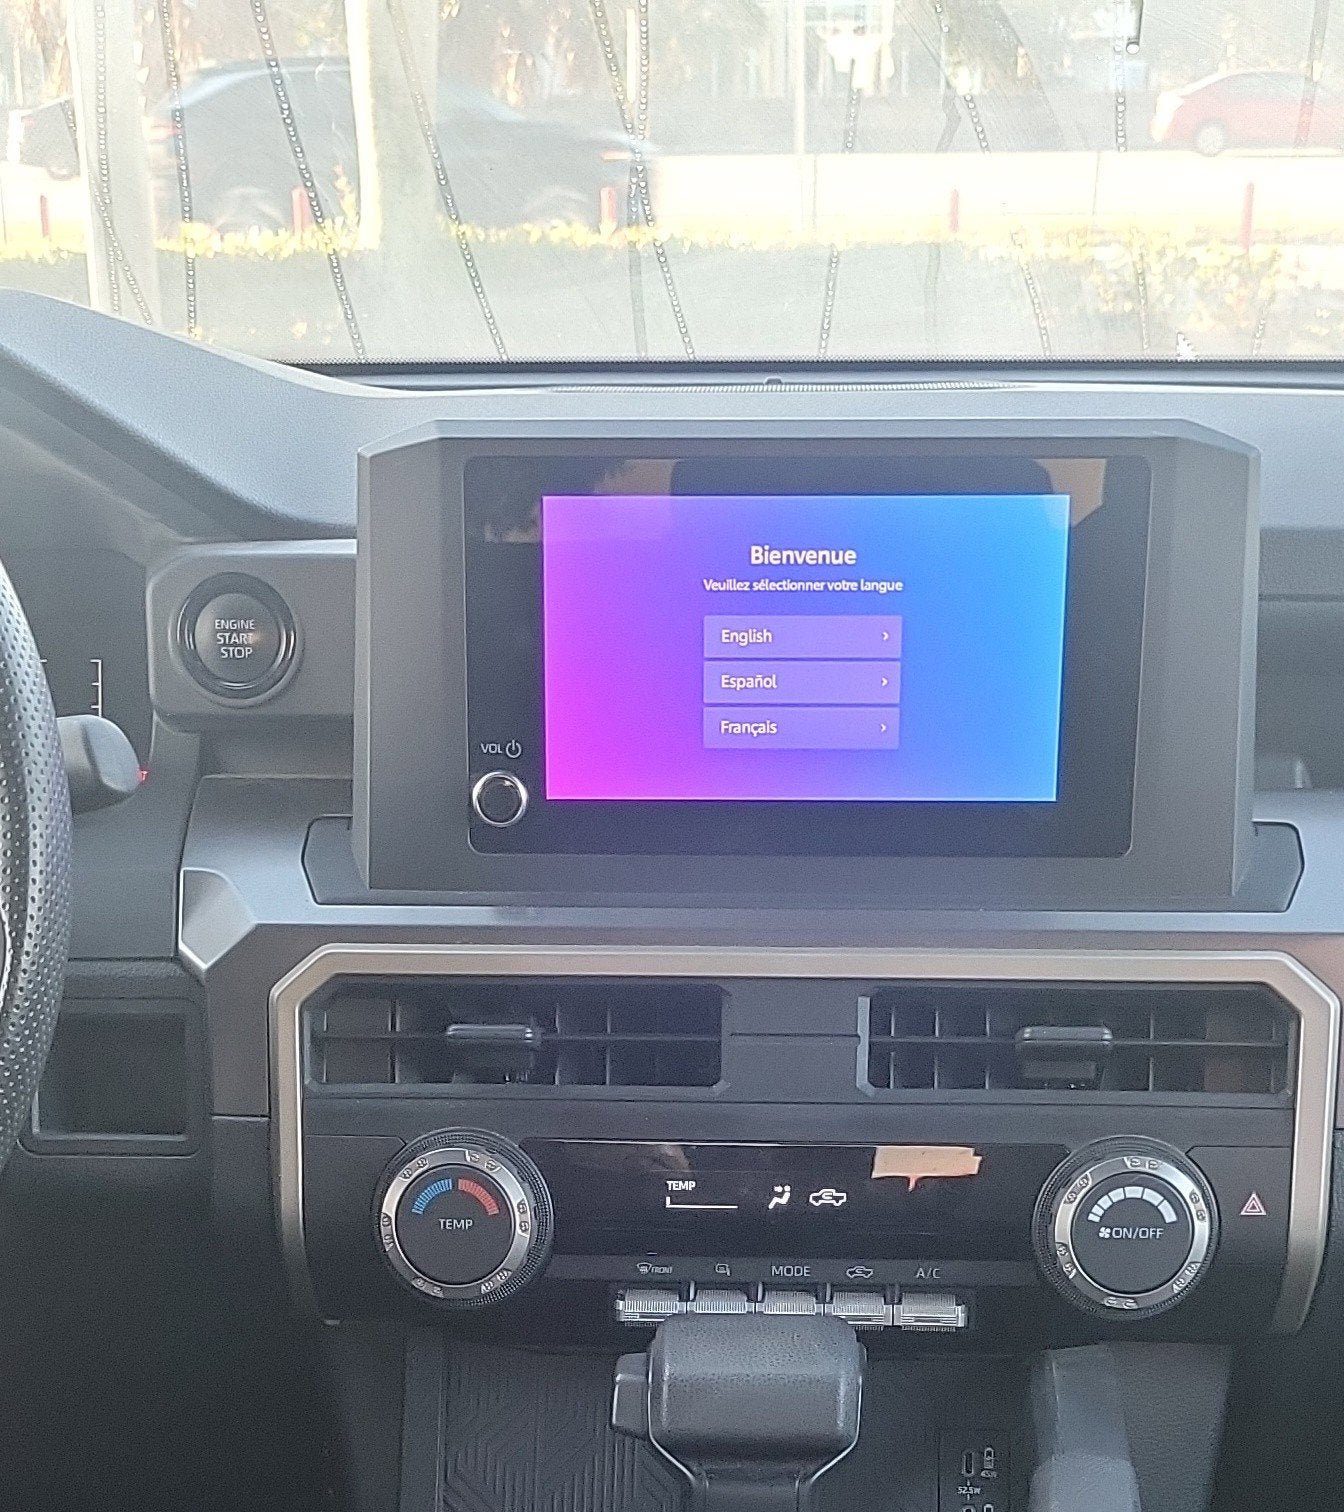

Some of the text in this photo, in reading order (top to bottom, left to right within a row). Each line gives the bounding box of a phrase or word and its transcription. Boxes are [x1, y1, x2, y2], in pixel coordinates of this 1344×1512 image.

[750, 545, 857, 565] Bienvenue
[703, 578, 904, 594] Veuillez sélectionner votre langue
[214, 619, 256, 630] ENGINE
[216, 632, 254, 645] START
[721, 629, 773, 646] English
[220, 647, 253, 659] STOP
[720, 674, 778, 690] Español
[720, 719, 778, 736] Français
[480, 743, 503, 754] VOL
[666, 1180, 696, 1191] TEMP
[439, 1218, 474, 1231] TEMP
[1111, 1227, 1164, 1240] ON/OFF
[771, 1265, 811, 1277] MODE
[916, 1267, 941, 1280] A/C
